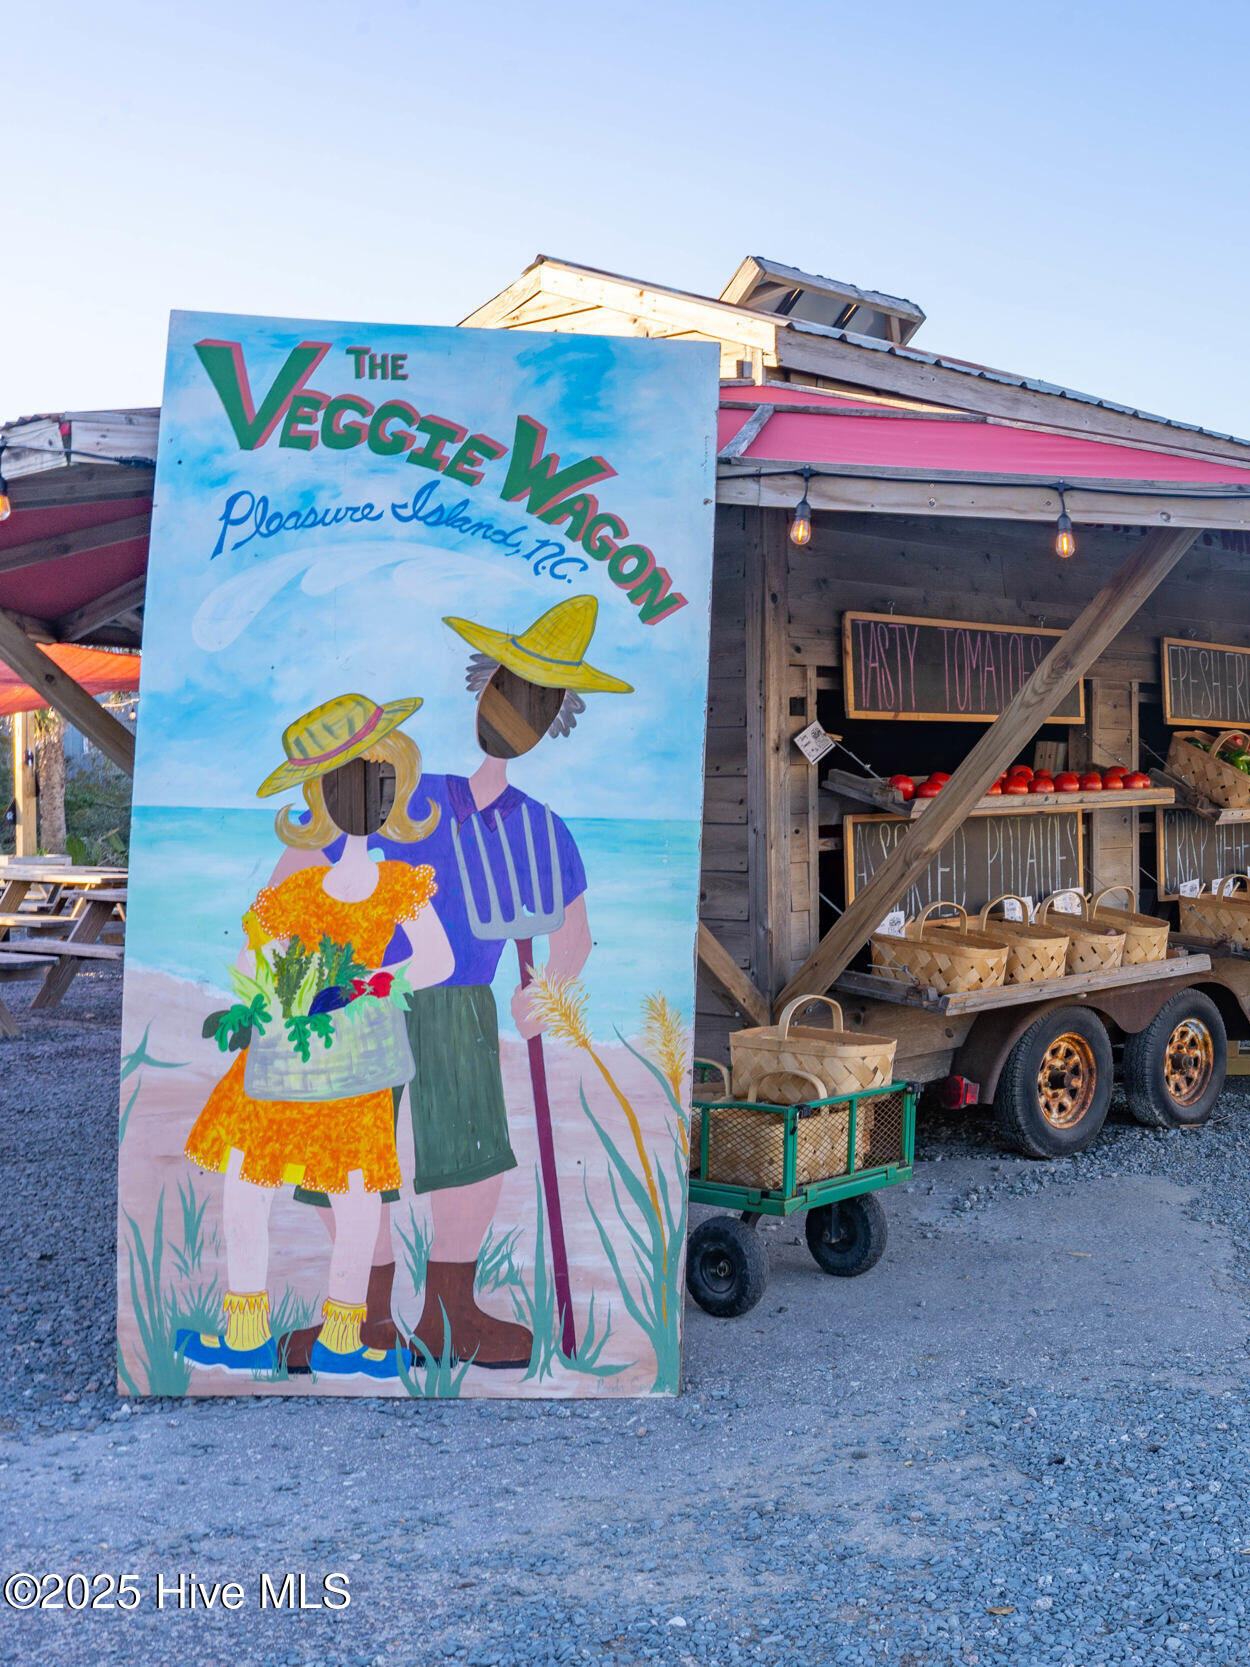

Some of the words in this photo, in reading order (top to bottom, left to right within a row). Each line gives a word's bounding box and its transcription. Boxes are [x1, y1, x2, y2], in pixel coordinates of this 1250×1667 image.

[345, 346, 409, 381] THE
[193, 340, 510, 487] VEGGIE
[500, 414, 689, 626] WAGON
[210, 490, 386, 561] Pleasure
[391, 479, 529, 556] Island,
[854, 620, 919, 711] TASTY
[1169, 646, 1223, 720] FRESH
[855, 822, 967, 917] ASTED
[986, 813, 1079, 903] POTATOES
